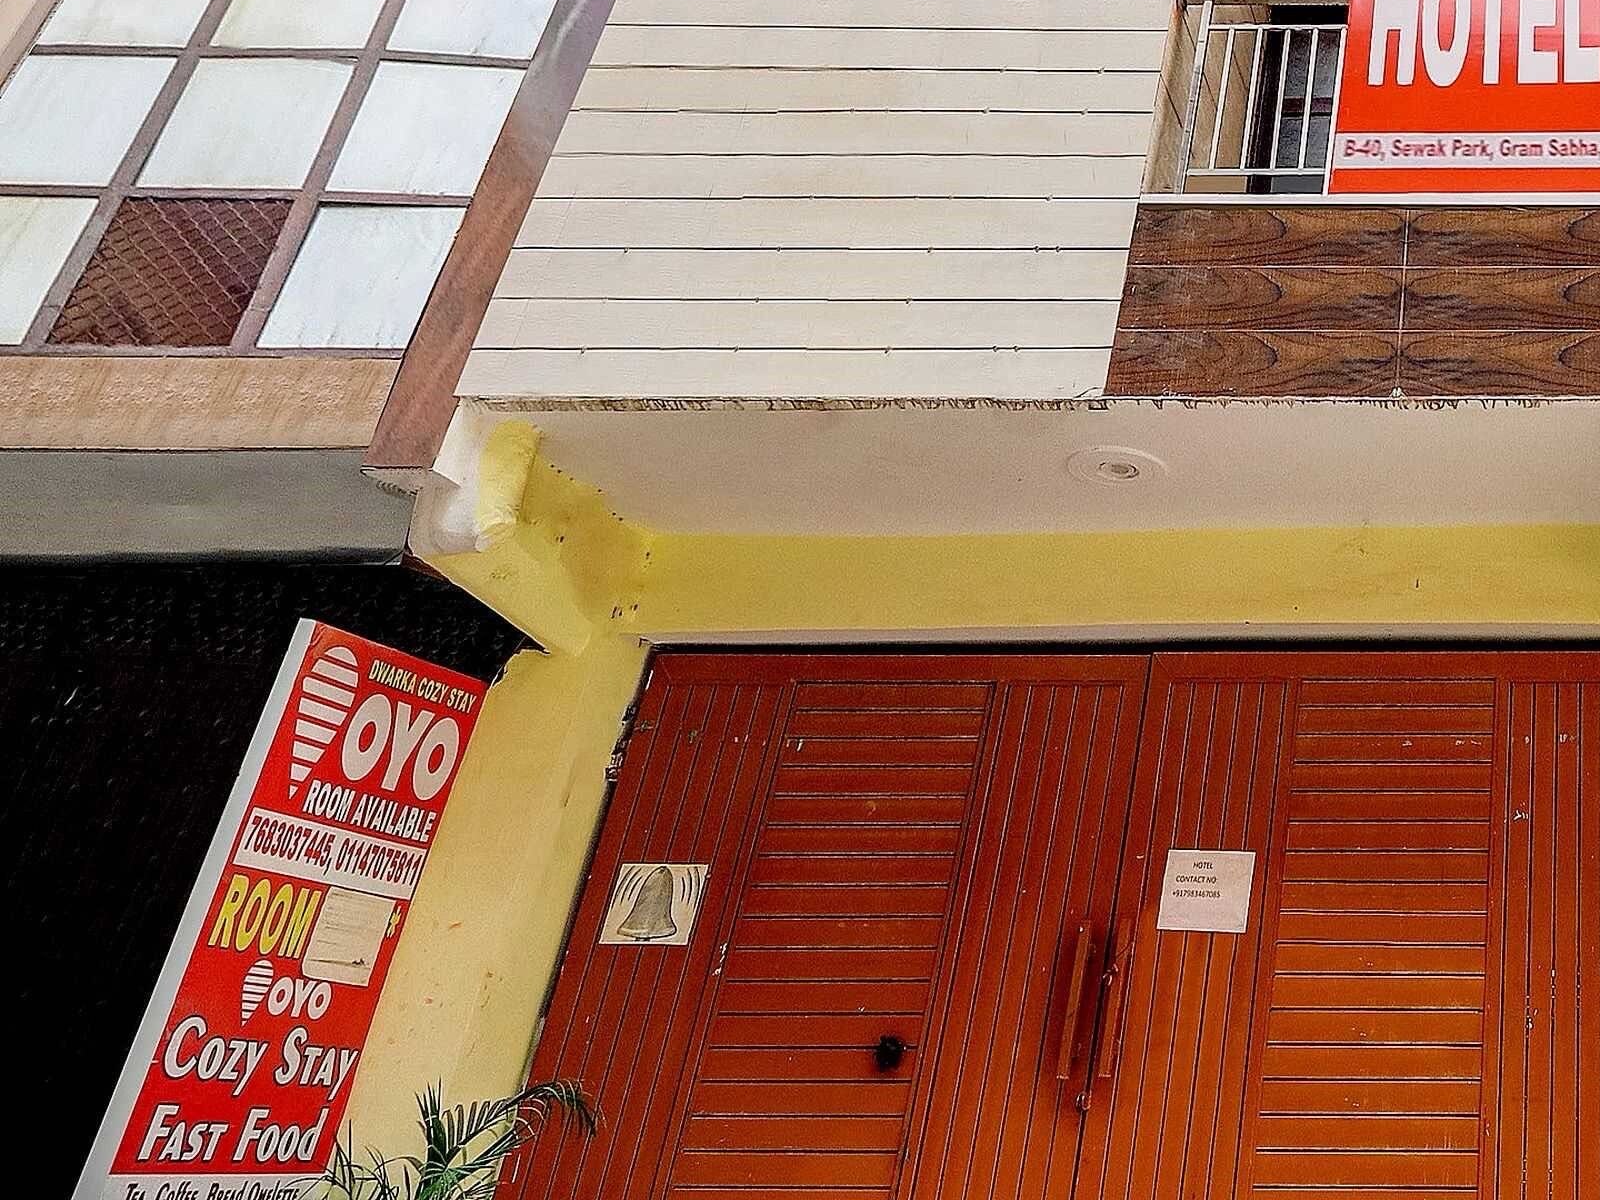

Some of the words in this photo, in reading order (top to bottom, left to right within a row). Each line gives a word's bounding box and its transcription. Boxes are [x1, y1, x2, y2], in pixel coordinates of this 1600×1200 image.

[1343, 139, 1385, 161] B-40,
[1391, 139, 1446, 157] Sewak
[1452, 139, 1493, 161] Park,
[1500, 140, 1542, 157] Gram
[369, 660, 417, 694] DWARKA
[418, 677, 449, 703] COZY
[447, 688, 477, 713] STAY
[341, 694, 460, 801] OYO
[302, 779, 356, 822] ROOM
[350, 793, 437, 842] AVAILABLE
[1175, 875, 1205, 883] CONTACT
[1193, 861, 1213, 869] HOTEL
[208, 874, 322, 959] ROOM
[267, 976, 331, 1020] OYO
